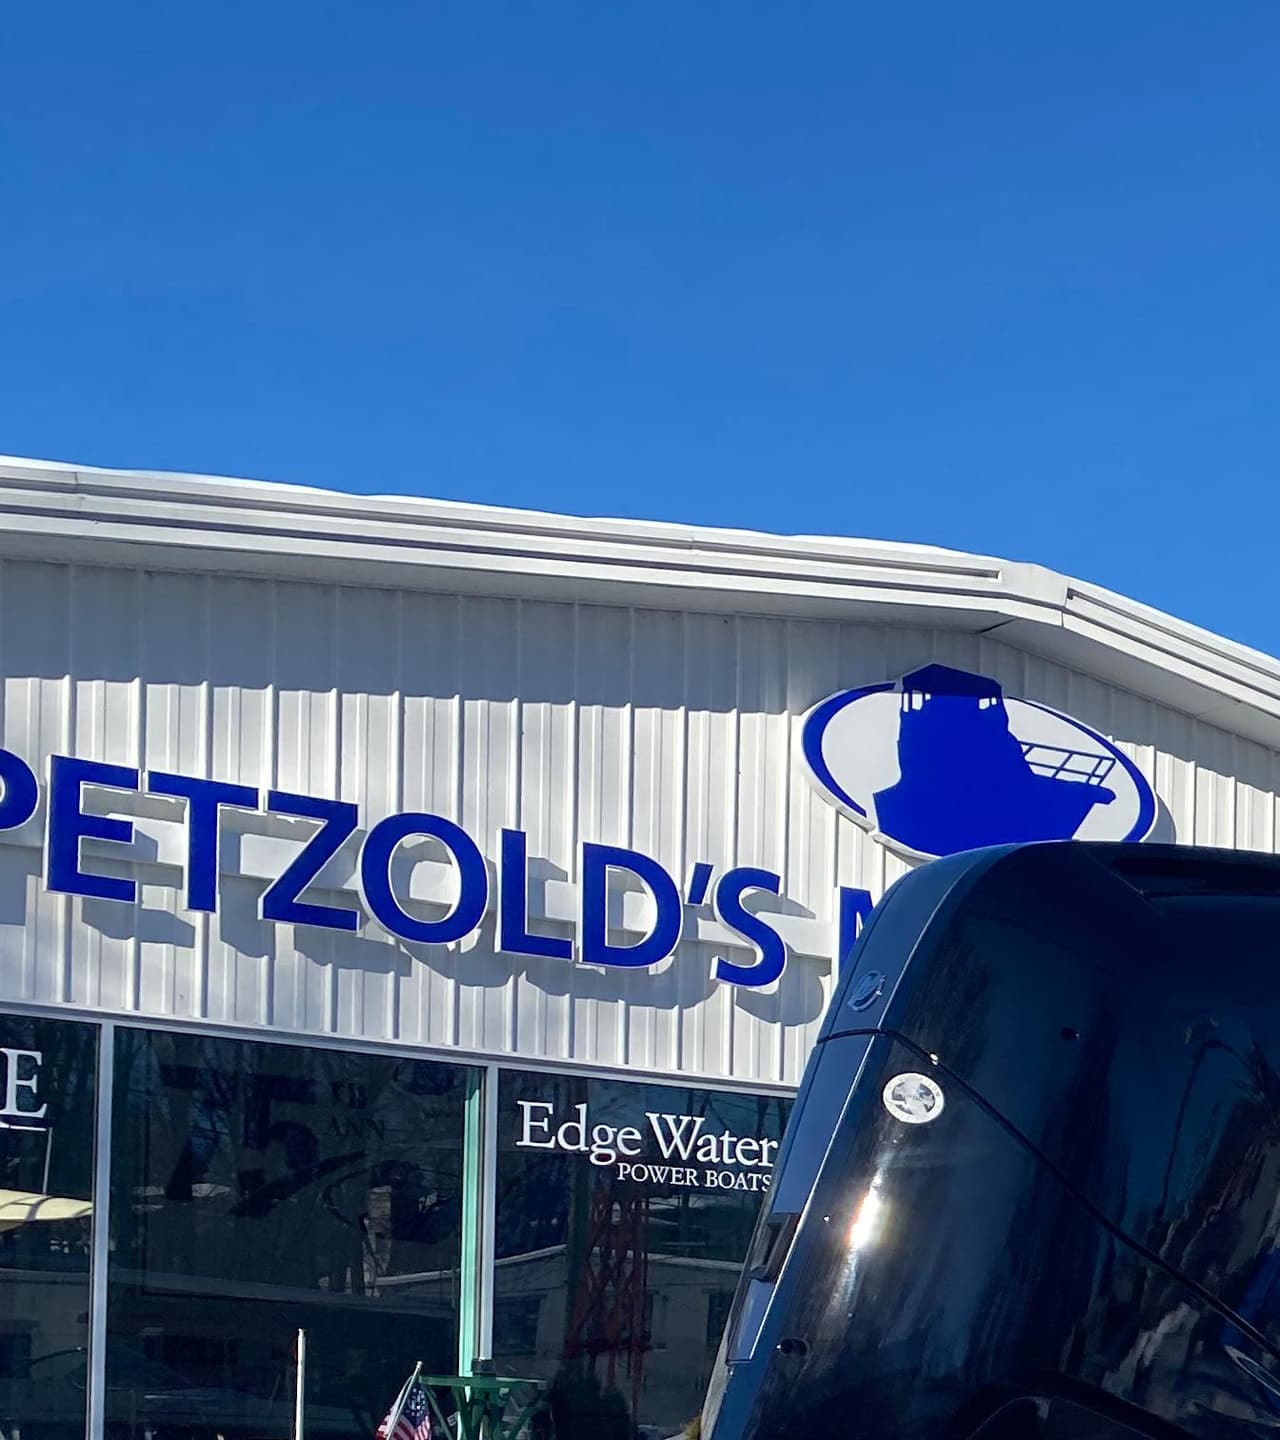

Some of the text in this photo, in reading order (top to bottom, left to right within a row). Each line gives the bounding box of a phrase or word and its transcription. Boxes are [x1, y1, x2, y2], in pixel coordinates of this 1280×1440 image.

[516, 1100, 642, 1165] Edge
[645, 1112, 778, 1167] Water
[617, 1162, 772, 1192] POWER BOATS
